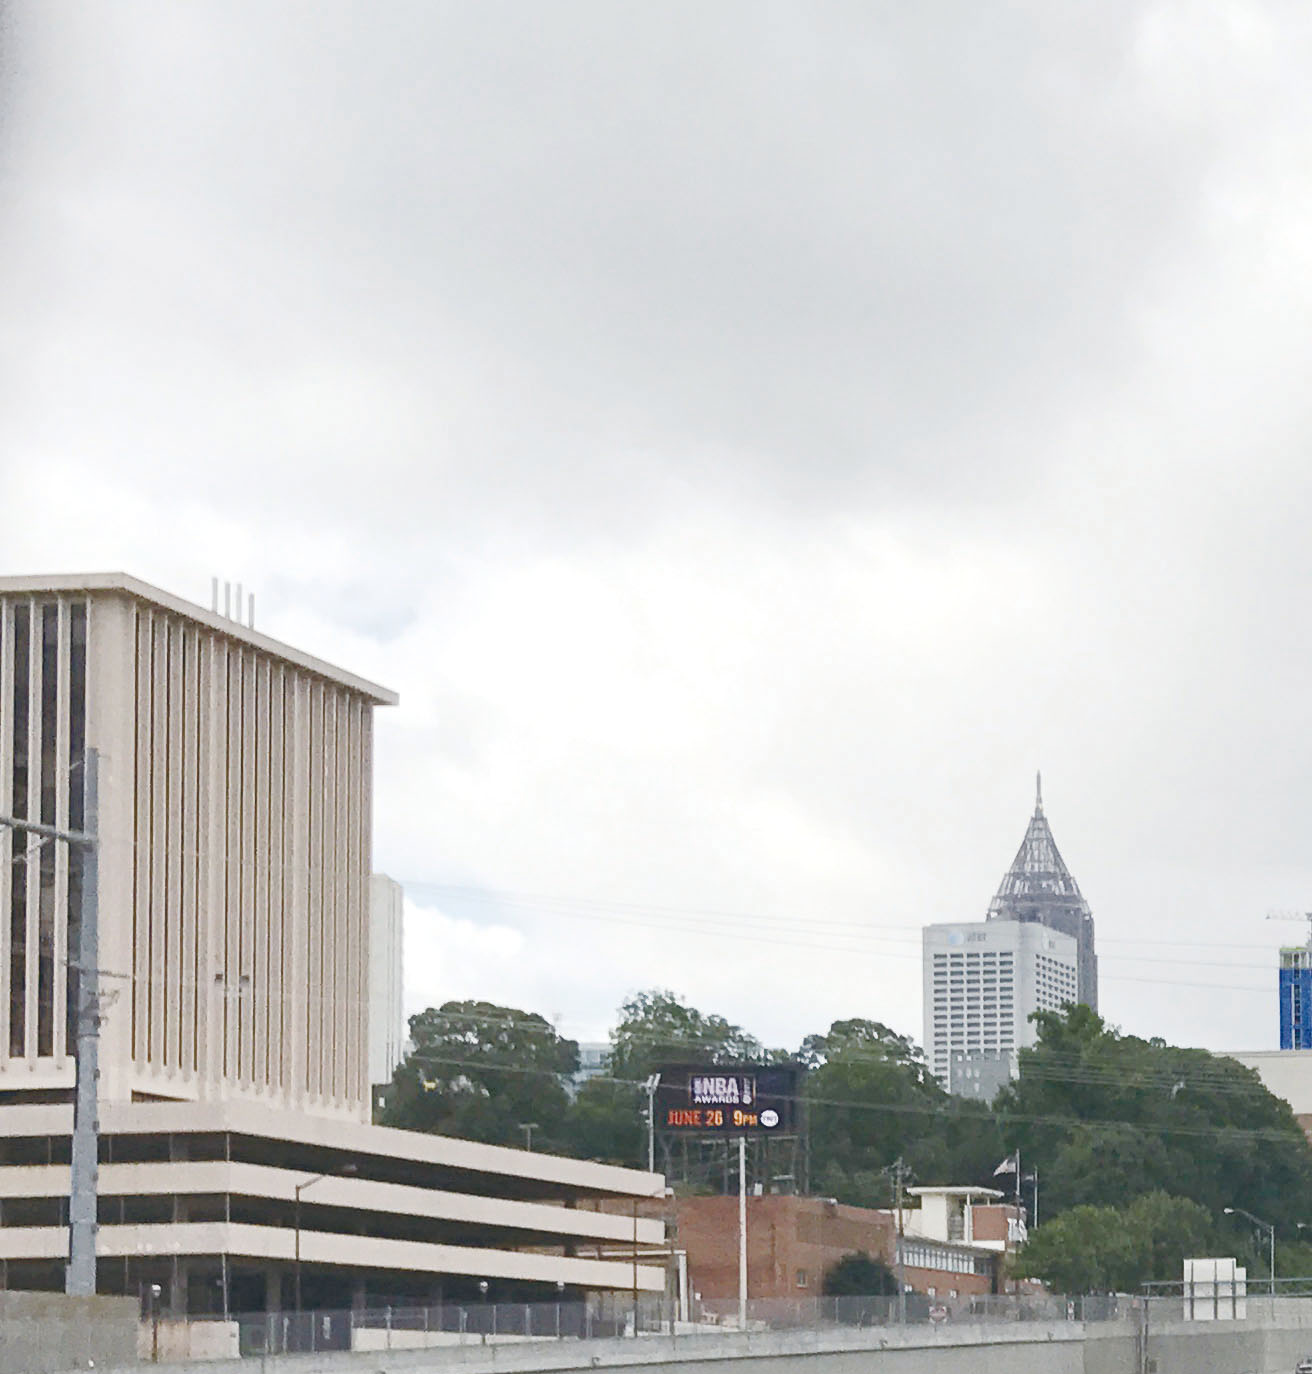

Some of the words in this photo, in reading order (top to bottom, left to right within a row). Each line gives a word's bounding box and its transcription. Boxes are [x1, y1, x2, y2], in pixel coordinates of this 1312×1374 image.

[703, 1077, 739, 1096] NBA
[694, 1096, 740, 1104] AWARDS
[667, 1110, 702, 1126] JUNE
[705, 1110, 723, 1126] 26
